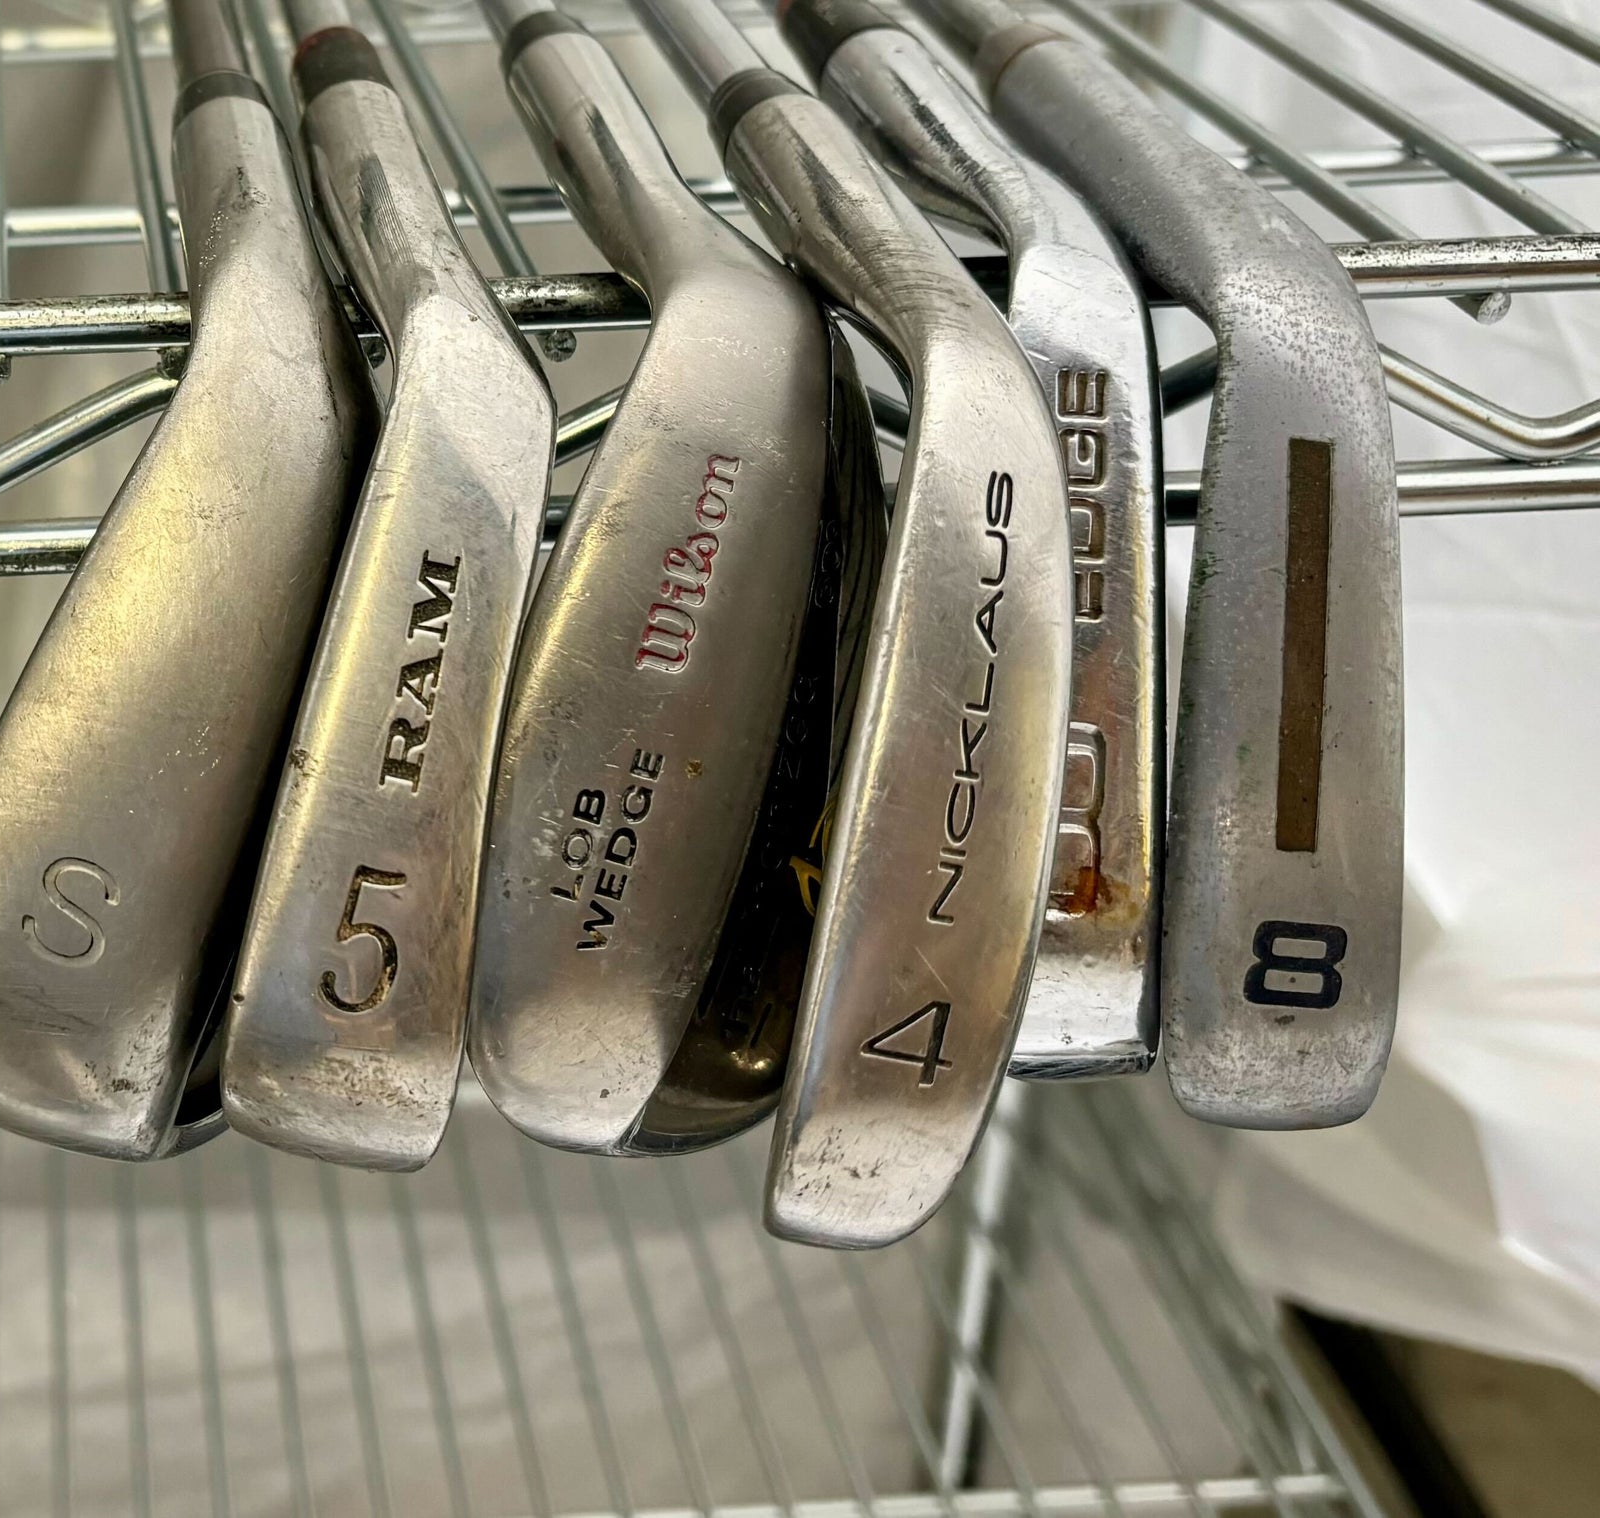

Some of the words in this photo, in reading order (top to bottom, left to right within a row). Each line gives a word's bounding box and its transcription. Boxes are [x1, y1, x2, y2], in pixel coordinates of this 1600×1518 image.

[634, 453, 741, 674] Wilson
[380, 550, 461, 794] RAM
[927, 470, 1014, 926] NICKLAUS
[21, 856, 121, 967] S
[551, 787, 606, 902] LOB
[577, 747, 665, 951] WEDGE
[318, 864, 407, 1014] 5
[1243, 920, 1348, 1009] 8
[860, 1000, 953, 1088] 4
